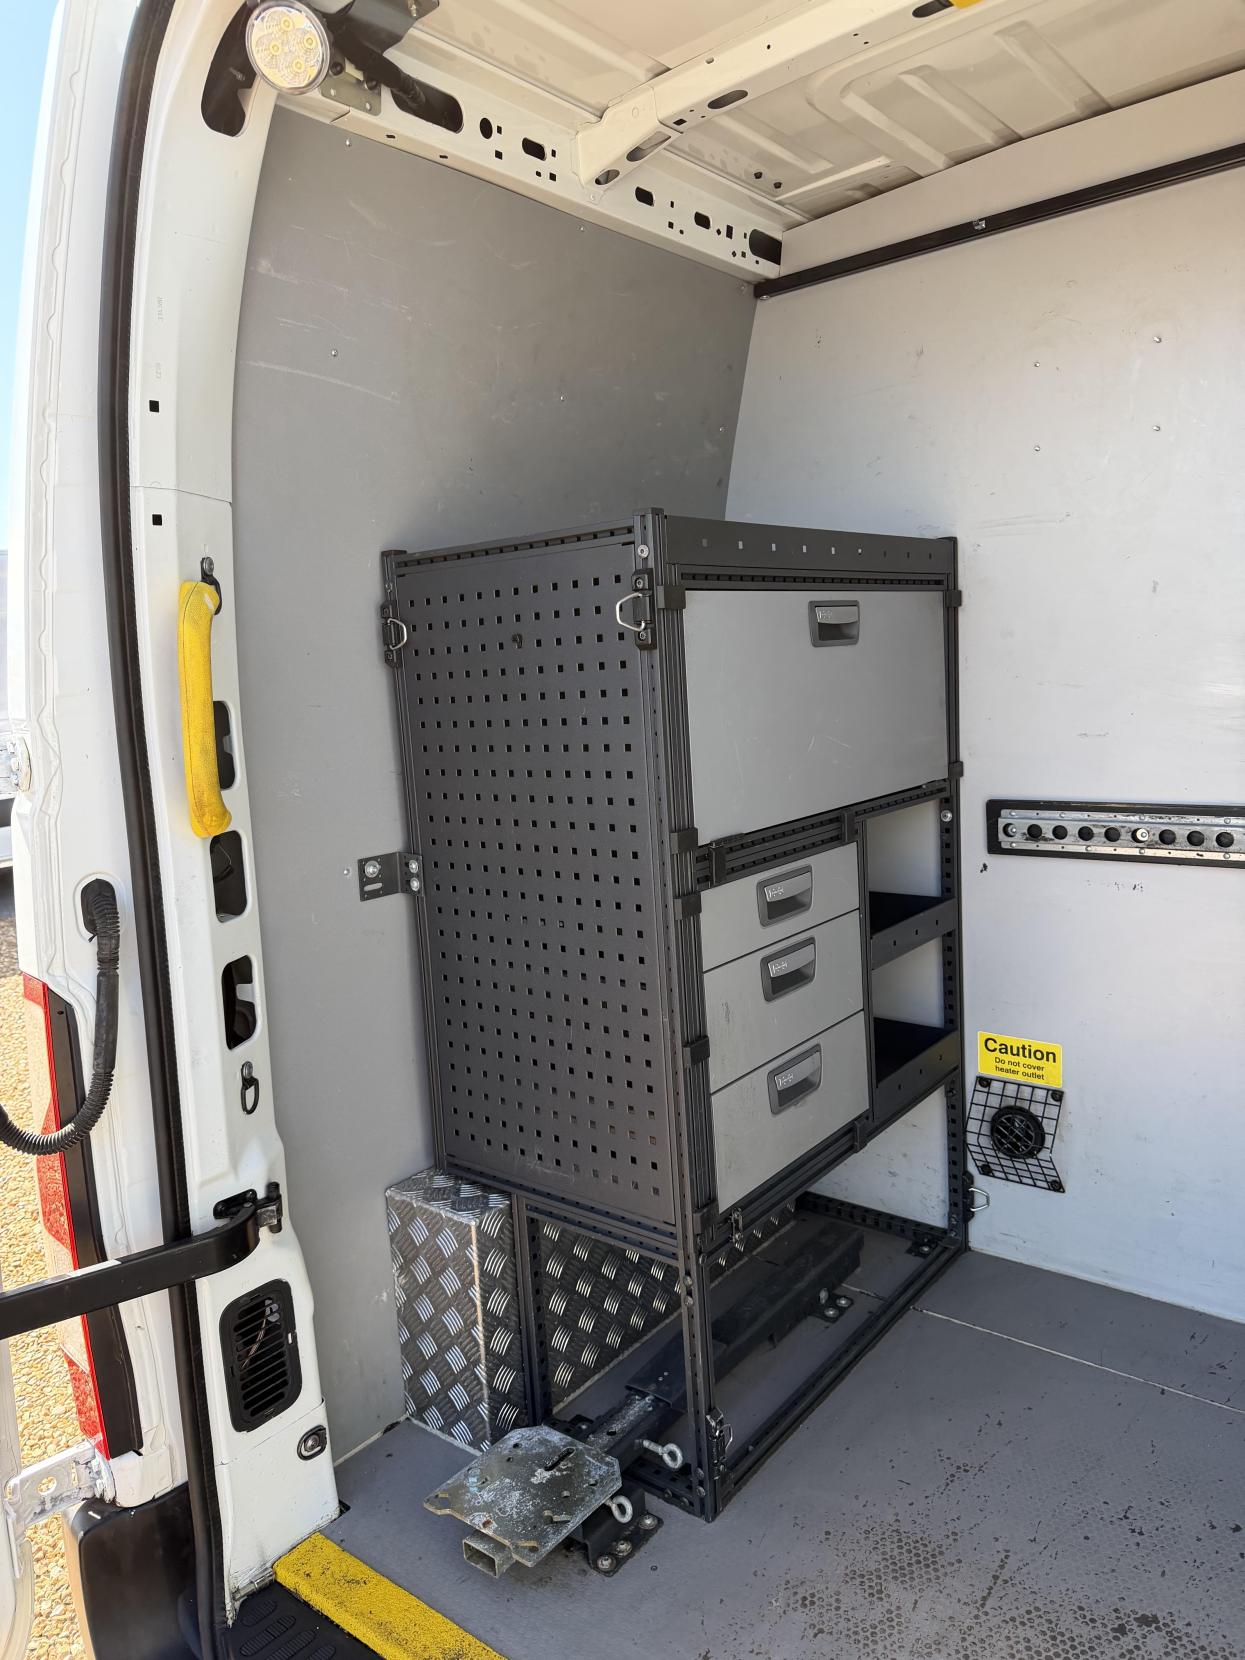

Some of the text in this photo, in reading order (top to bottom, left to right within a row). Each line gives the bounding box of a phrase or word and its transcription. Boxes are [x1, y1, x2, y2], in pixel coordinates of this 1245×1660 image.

[984, 1037, 1057, 1063] Caution
[994, 1057, 1045, 1071] Do not cover
[995, 1065, 1045, 1080] heater outlet
